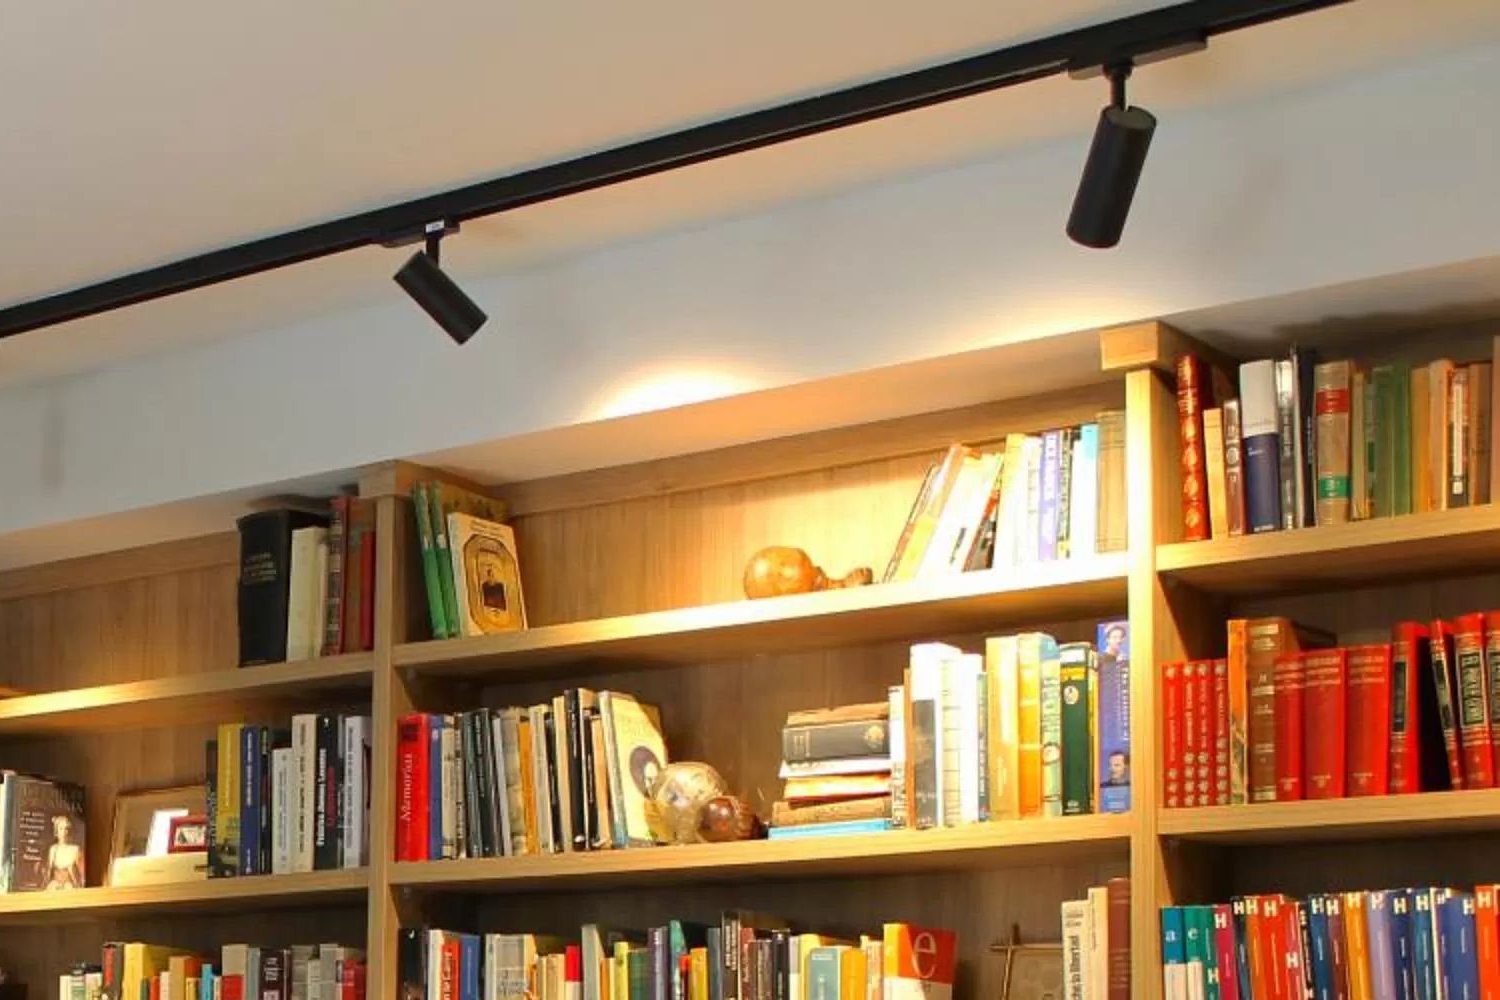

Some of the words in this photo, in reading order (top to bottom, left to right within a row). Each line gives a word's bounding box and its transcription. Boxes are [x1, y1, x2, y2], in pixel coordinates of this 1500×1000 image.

[400, 753, 412, 822] Memorias
[1234, 901, 1245, 915] H
[1246, 899, 1258, 915] H
[1264, 901, 1277, 917] H
[1312, 898, 1324, 914] H
[1393, 897, 1406, 914] H
[1416, 895, 1429, 911] H
[1215, 913, 1227, 928] H
[912, 932, 937, 979] e
[1285, 952, 1298, 968] H
